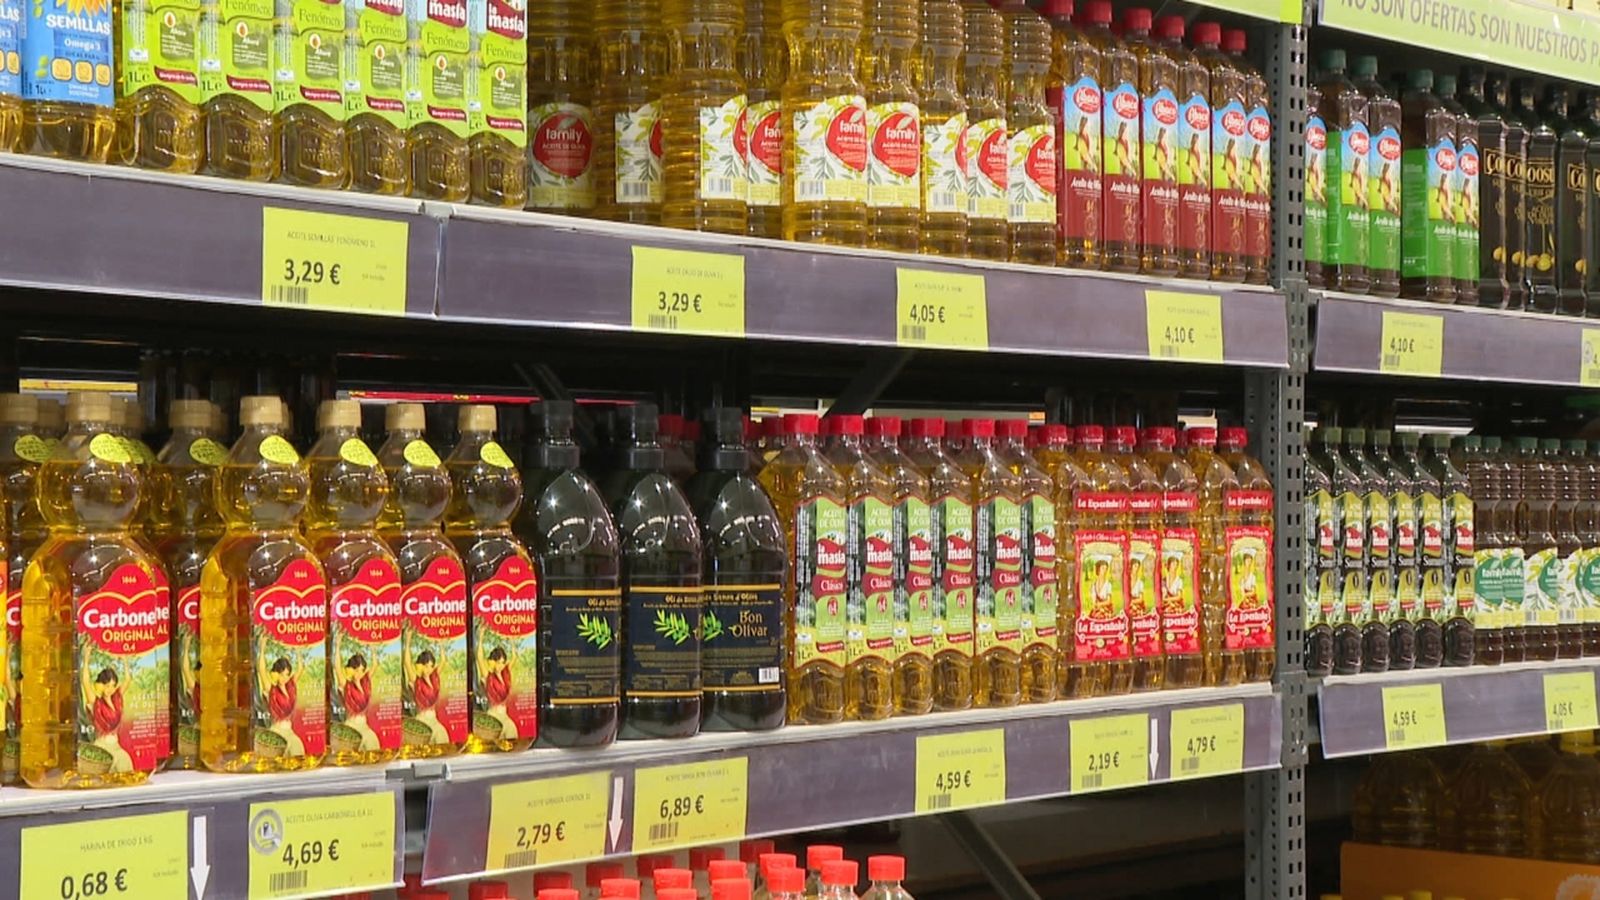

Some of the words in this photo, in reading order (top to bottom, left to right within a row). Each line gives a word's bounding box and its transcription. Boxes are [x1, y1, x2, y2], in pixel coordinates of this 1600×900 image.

[428, 0, 467, 20] masía
[489, 5, 498, 19] la
[46, 14, 111, 36] SEMILLAS
[488, 14, 525, 33] masía
[1410, 0, 1476, 36] OFERTAS
[1479, 14, 1511, 45] SON
[1514, 21, 1587, 63] NUESTROS
[64, 38, 94, 50] Omega
[546, 128, 583, 144] family
[886, 127, 917, 142] family
[284, 258, 324, 286] 3,29
[329, 263, 341, 285] €
[658, 291, 690, 314] 3,29
[693, 294, 702, 314] €
[909, 304, 936, 325] 4,05
[938, 306, 946, 324] €
[1165, 325, 1186, 345] 4,10
[1188, 327, 1195, 344] €
[1390, 338, 1408, 355] 4,10
[1409, 339, 1415, 354] €
[352, 618, 399, 631] ORIGINAL
[421, 615, 466, 627] ORIGINAL
[494, 612, 535, 625] ORIGINAL
[739, 609, 763, 625] Bon
[277, 620, 325, 635] ORIGINAL
[370, 630, 383, 640] 0,4
[439, 627, 451, 637] 0,4
[510, 624, 521, 634] 0,4
[730, 624, 768, 639] Olivar
[102, 628, 156, 644] ORIGINAL
[296, 634, 308, 643] 0,4
[123, 641, 136, 653] 0,4
[1553, 702, 1567, 717] 4,05
[1568, 702, 1573, 715] €
[1393, 711, 1410, 727] 4,59
[1411, 710, 1417, 725] €
[1187, 736, 1208, 756] 4,79
[1210, 735, 1216, 752] €
[1089, 752, 1110, 773] 2,19
[1113, 751, 1120, 768] €
[936, 771, 961, 793] 4,59
[964, 770, 971, 788] €
[660, 796, 691, 821] 6,89
[695, 794, 704, 814] €
[516, 823, 551, 849] 2,79
[555, 820, 566, 842] €
[282, 840, 323, 870] 4,69
[328, 838, 340, 861] €
[60, 871, 108, 900] 0,68
[114, 868, 128, 892] €
